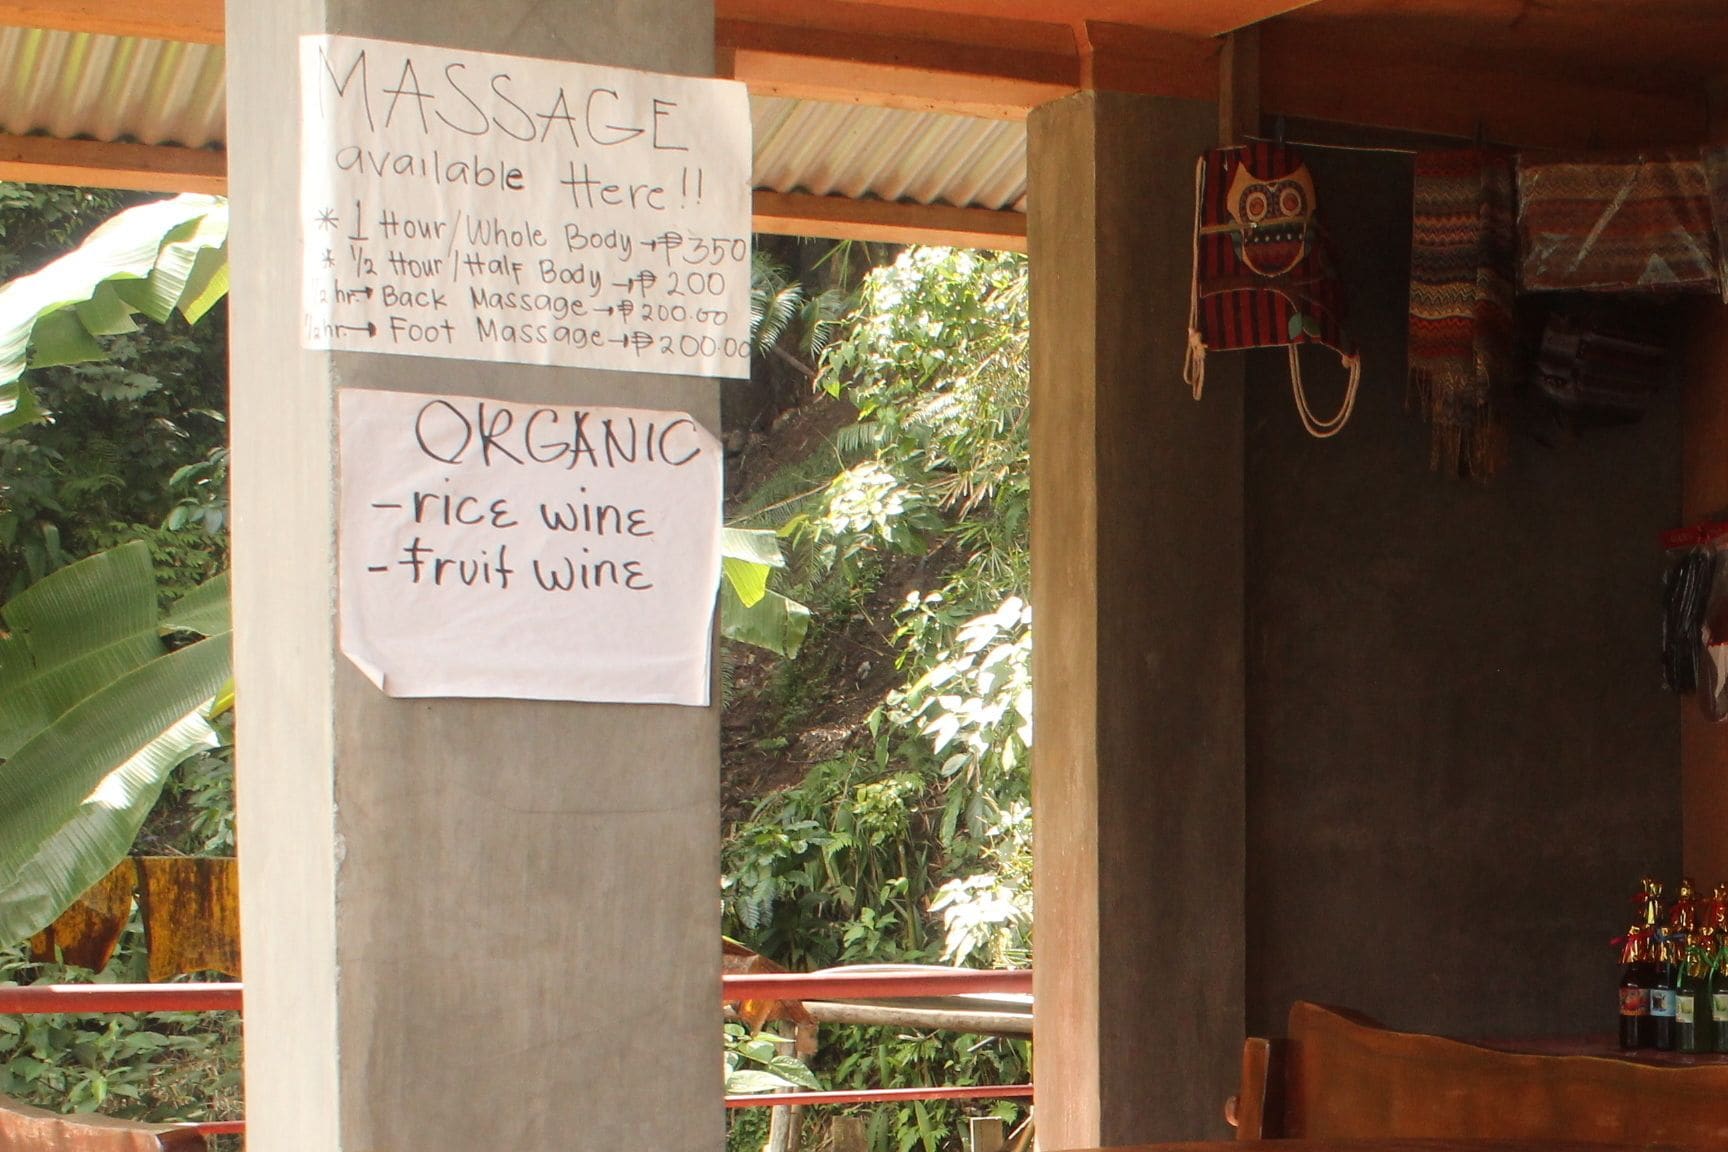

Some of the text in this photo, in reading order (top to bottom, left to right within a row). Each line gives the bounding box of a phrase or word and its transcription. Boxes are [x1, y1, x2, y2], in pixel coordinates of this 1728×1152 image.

[318, 47, 688, 151] MASSAGE
[336, 145, 703, 210] available Here!!
[565, 223, 633, 261] Body
[540, 259, 602, 297] Body
[382, 286, 447, 310] Back
[470, 286, 588, 317] Massage
[389, 316, 455, 344] Foot
[477, 318, 605, 349] Massage
[415, 399, 701, 470] ORGANIC
[540, 486, 654, 537] wine
